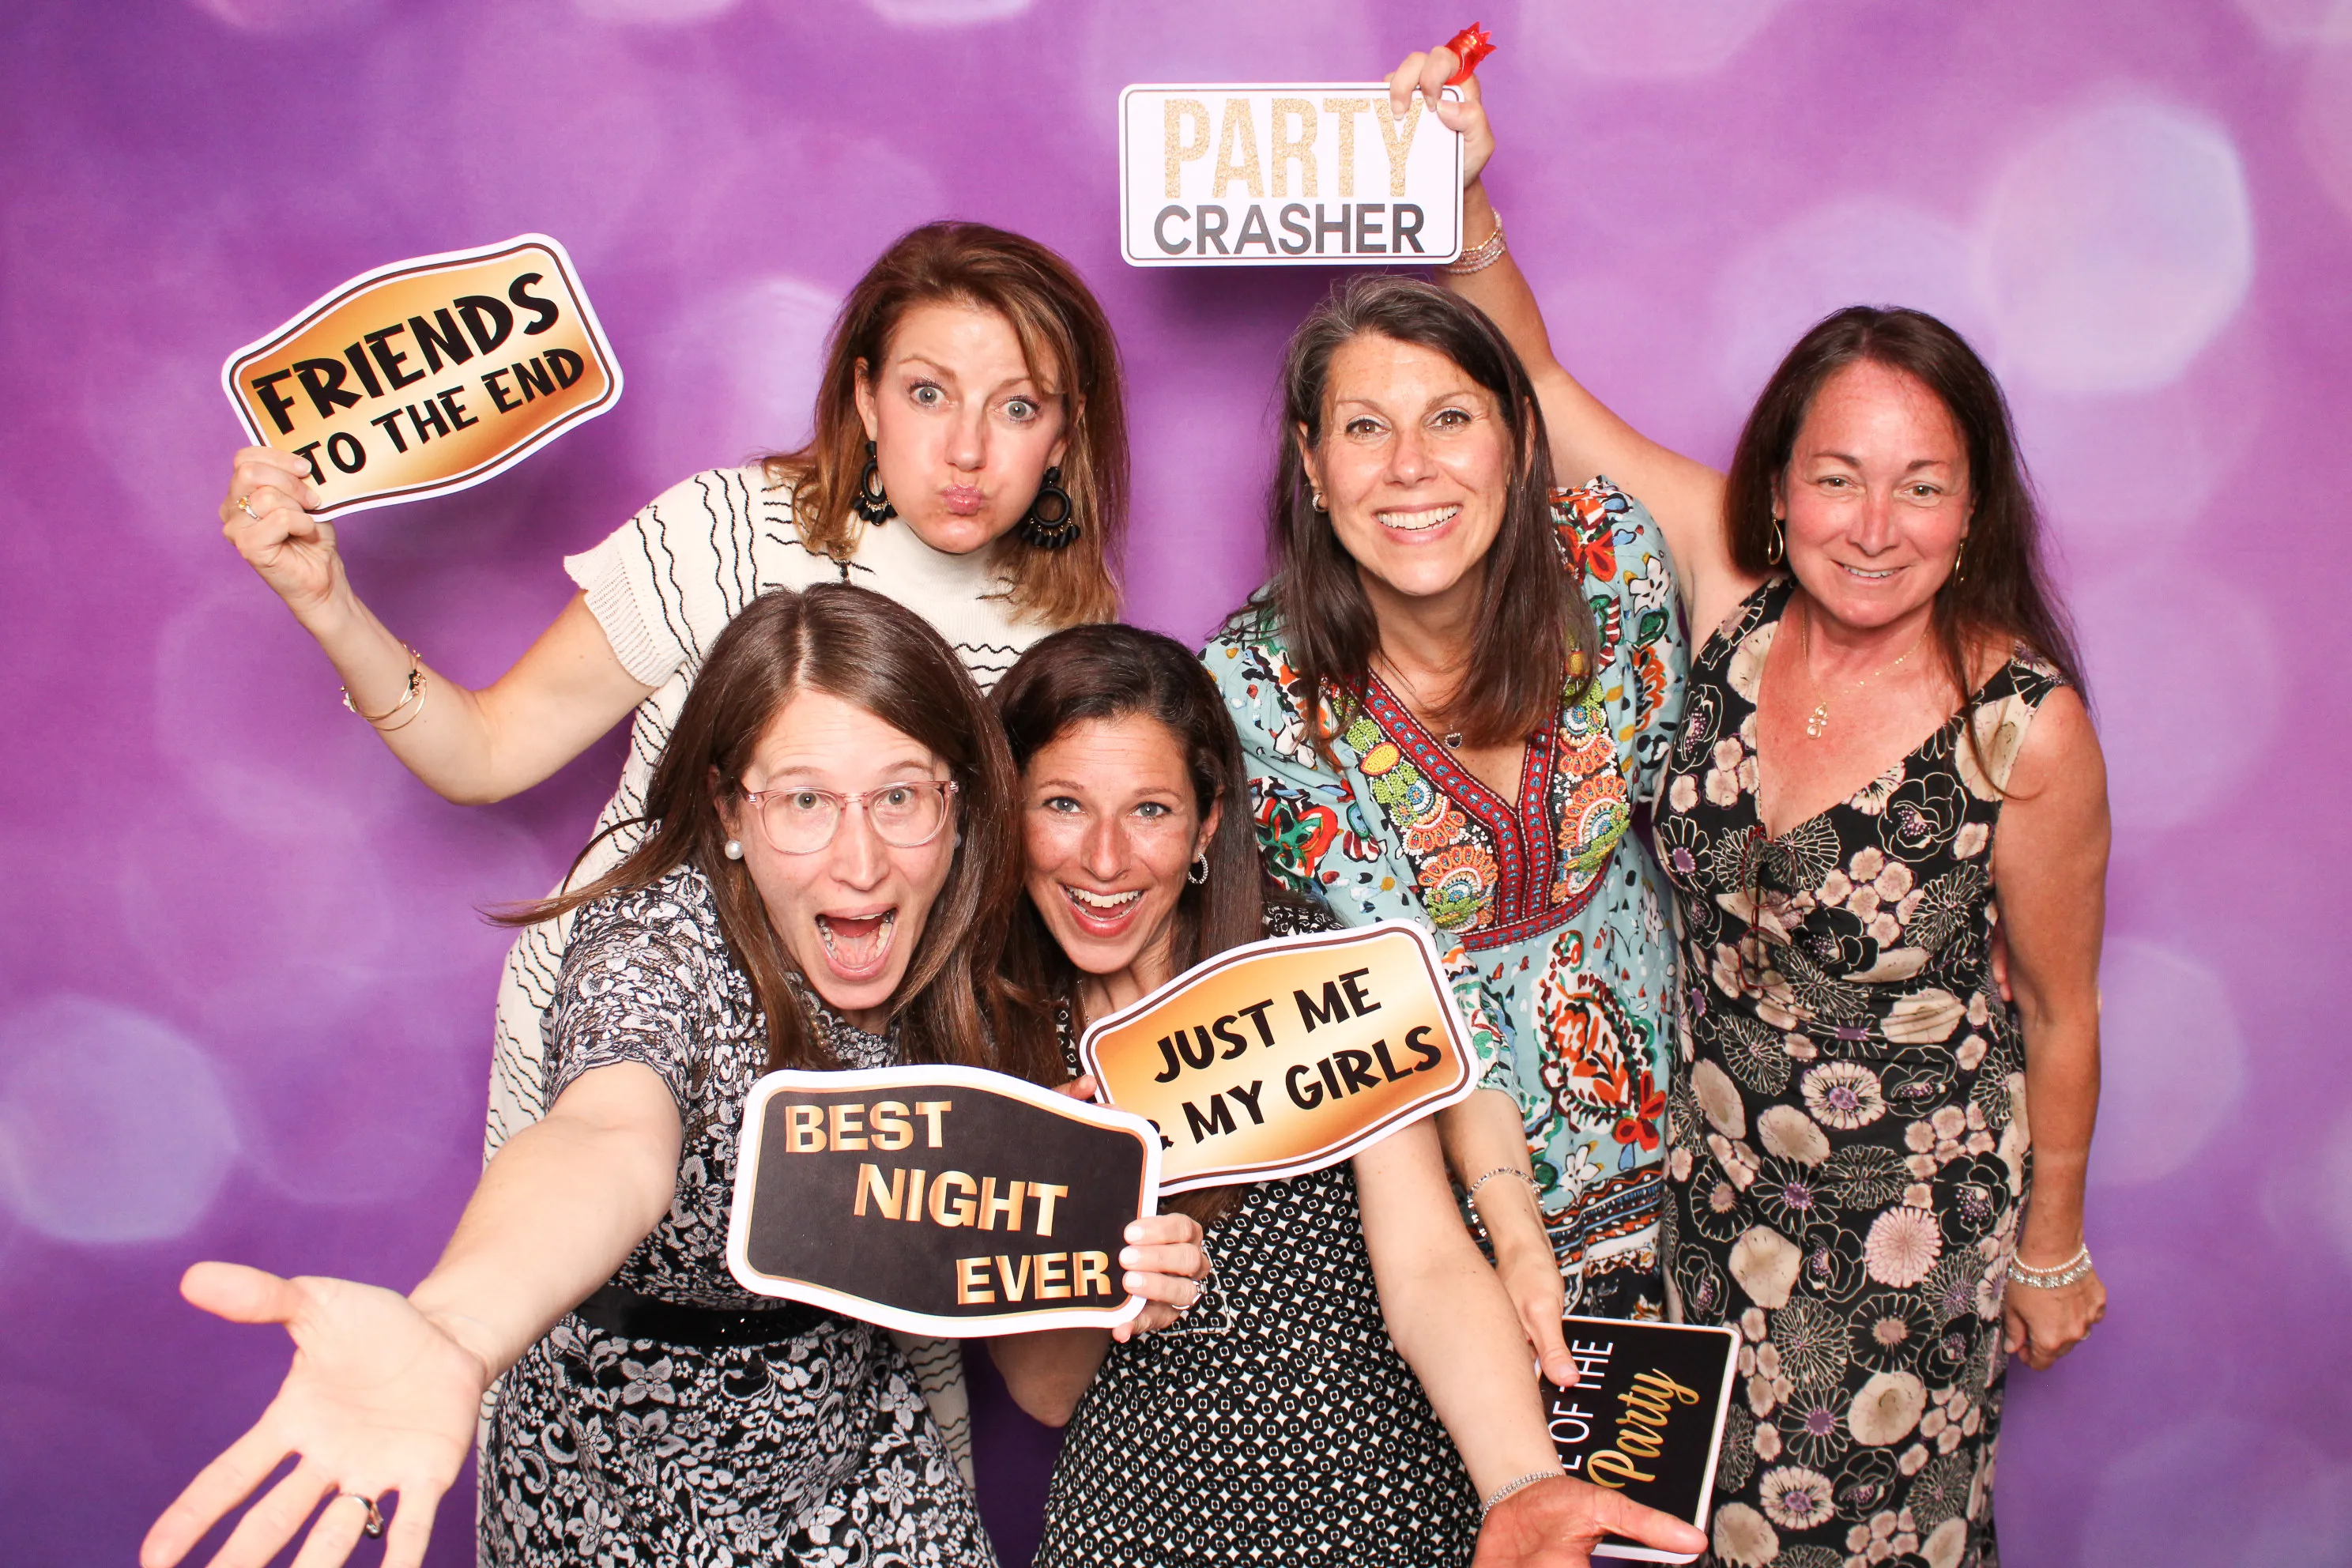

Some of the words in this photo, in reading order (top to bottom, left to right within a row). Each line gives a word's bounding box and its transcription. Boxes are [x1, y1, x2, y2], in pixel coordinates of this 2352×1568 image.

[1163, 97, 1424, 199] PARTY
[1154, 203, 1426, 255] CRASHER
[251, 273, 560, 435] FRIENDS
[292, 432, 367, 486] TO
[370, 385, 479, 454] THE
[481, 348, 585, 414] END
[1154, 998, 1276, 1084] JUST
[1293, 967, 1382, 1034] ME
[785, 1100, 952, 1154] BEST
[1182, 1080, 1265, 1144] MY
[1285, 1025, 1442, 1111] GIRLS
[854, 1163, 1069, 1238] NIGHT
[956, 1250, 1113, 1306] EVER
[1547, 1400, 1594, 1443] OF
[1587, 1368, 1699, 1489] Party
